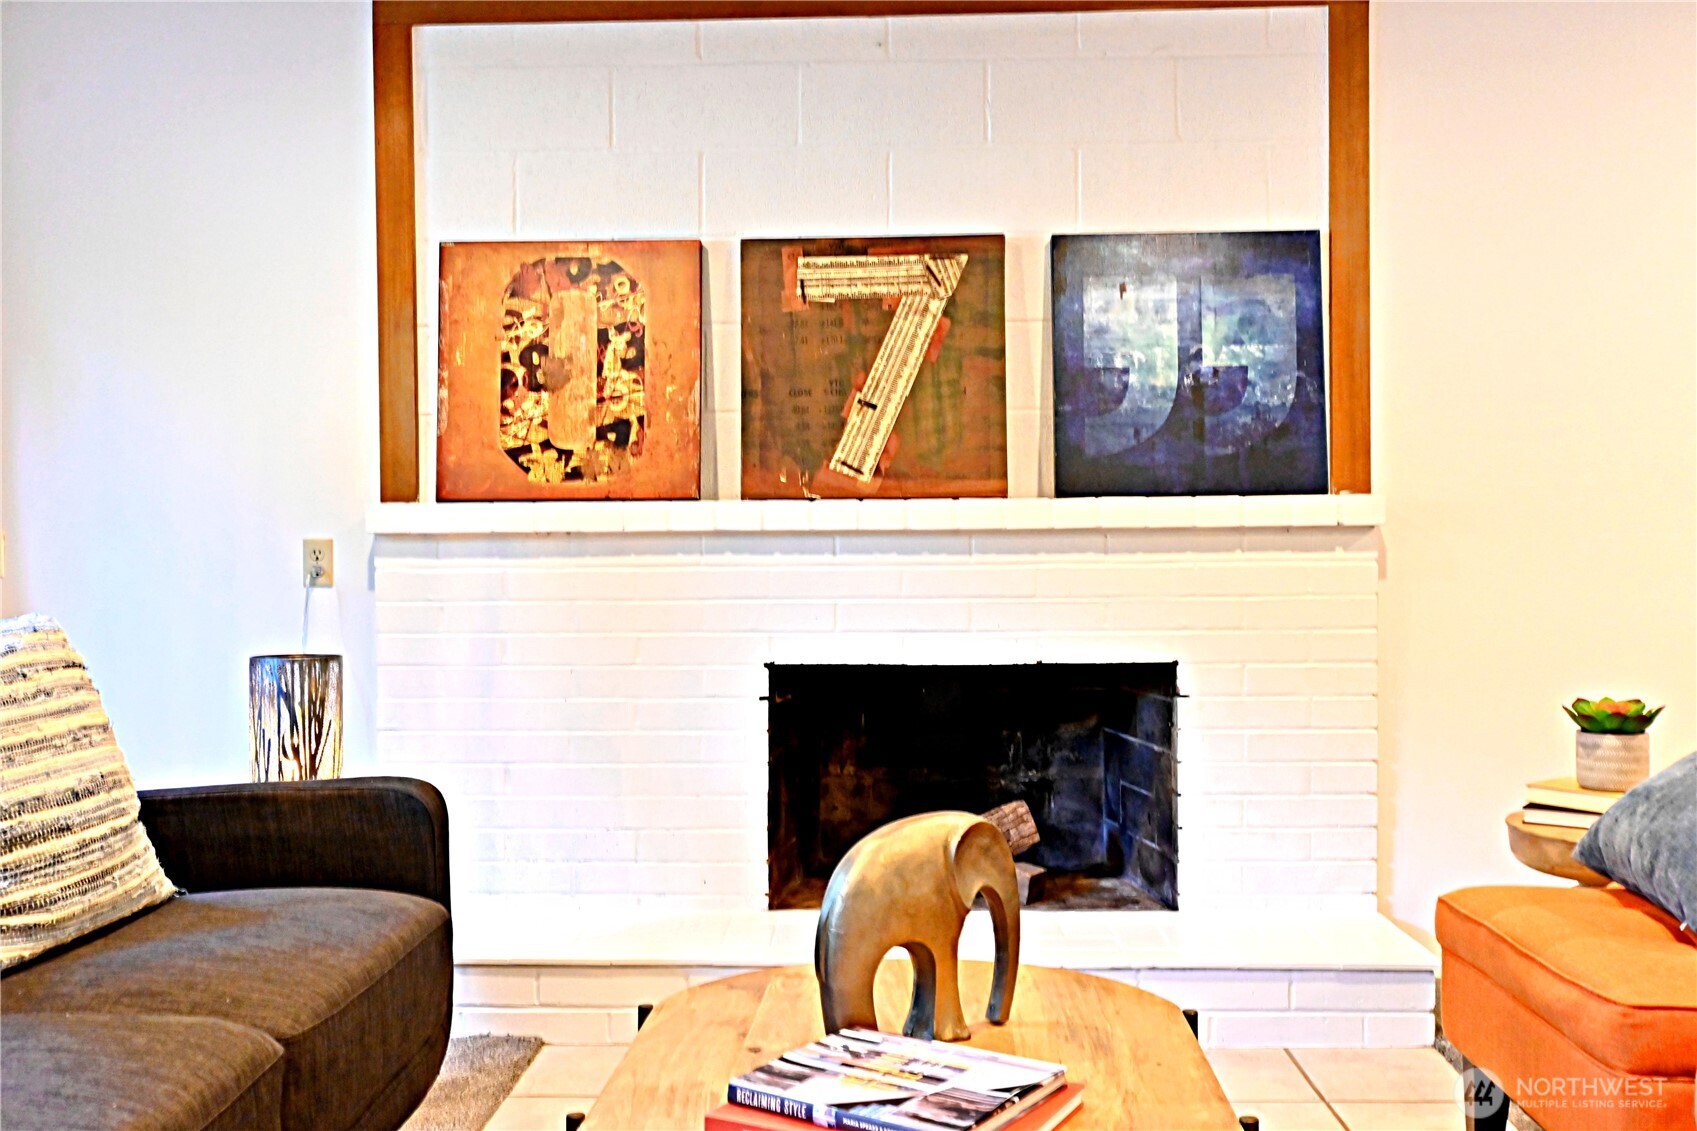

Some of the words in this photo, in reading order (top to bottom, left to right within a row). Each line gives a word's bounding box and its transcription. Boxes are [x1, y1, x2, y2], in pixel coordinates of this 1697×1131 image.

[796, 254, 969, 484] 7
[736, 1086, 781, 1113] RECLAIMING
[783, 1098, 807, 1119] STYLE
